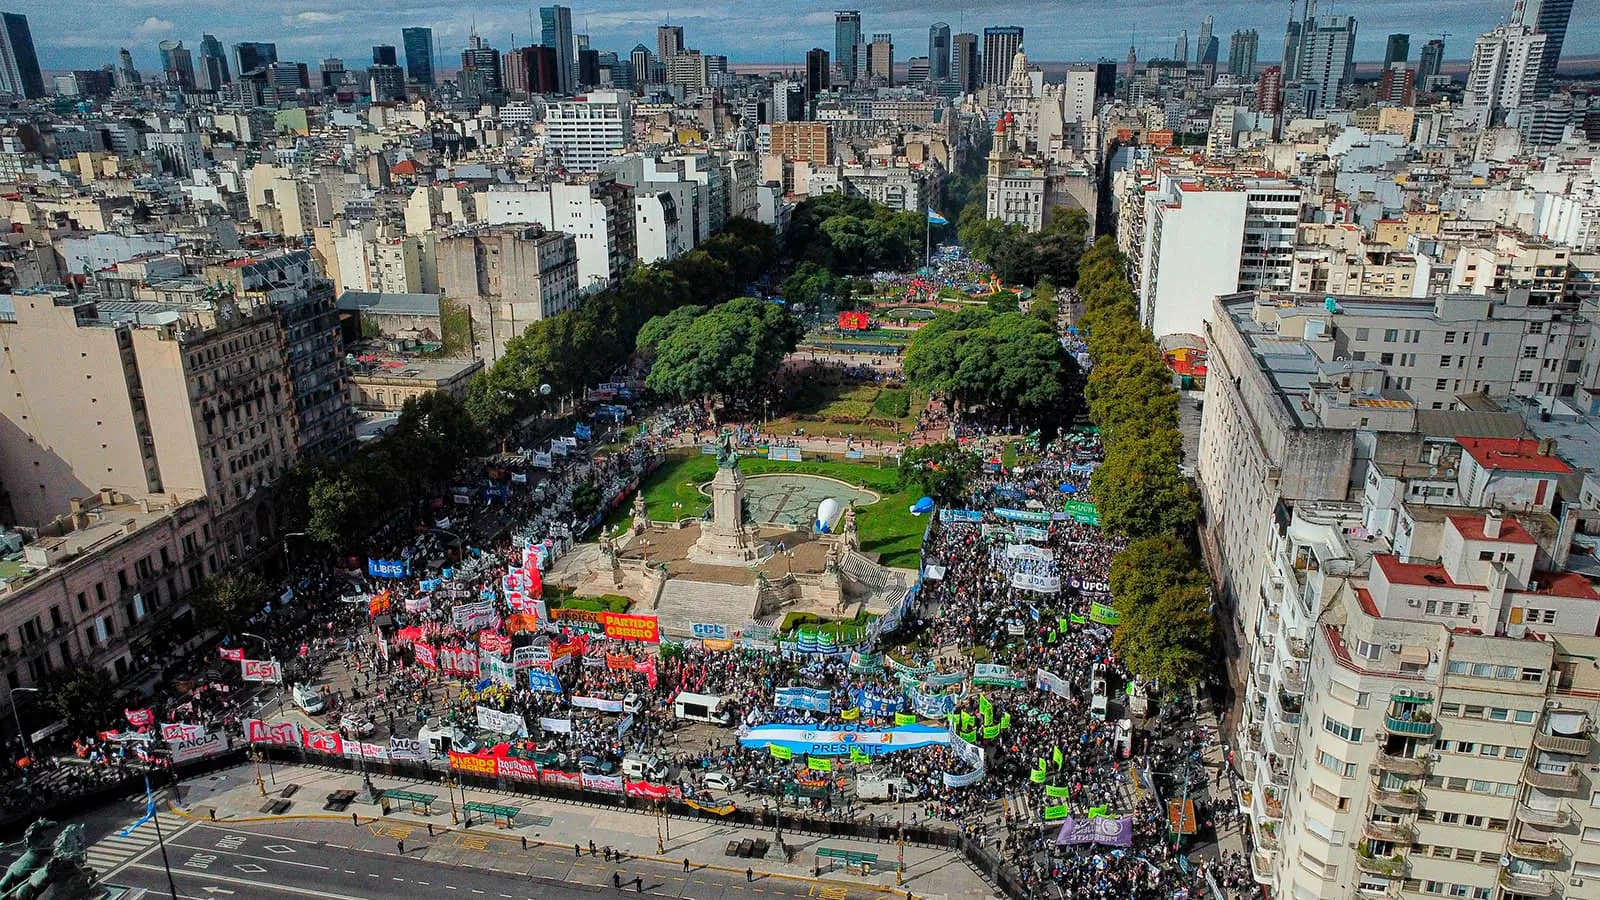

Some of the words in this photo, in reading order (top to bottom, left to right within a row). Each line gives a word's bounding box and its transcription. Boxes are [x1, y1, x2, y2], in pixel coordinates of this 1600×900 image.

[1082, 581, 1110, 591] UPCN
[606, 616, 656, 630] PARTIDO
[606, 626, 653, 639] OBRERO
[815, 723, 881, 733] UOCRA
[178, 733, 220, 750] ANCLA
[811, 744, 883, 755] PRESENTE
[449, 754, 495, 767] PARTIDO
[215, 835, 247, 849] BUS
[183, 853, 217, 869] BUS
